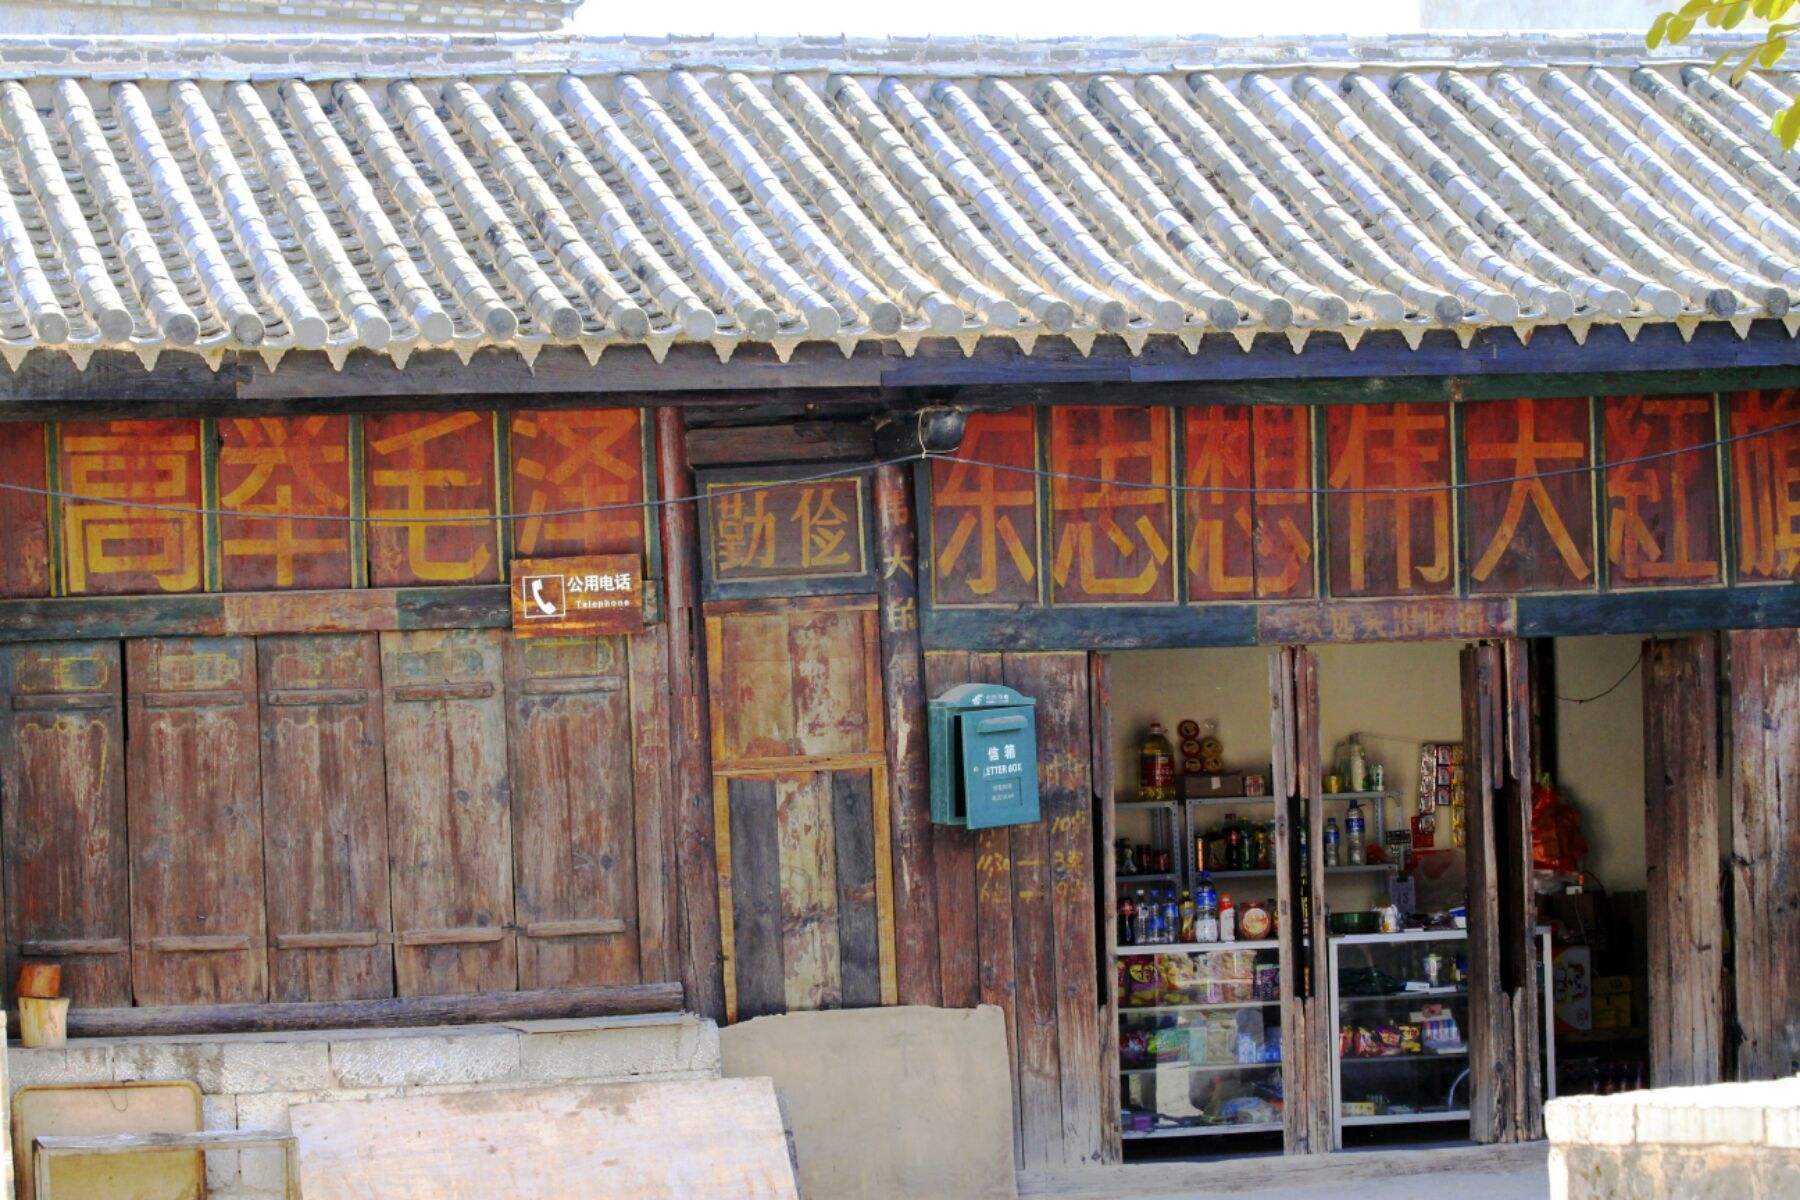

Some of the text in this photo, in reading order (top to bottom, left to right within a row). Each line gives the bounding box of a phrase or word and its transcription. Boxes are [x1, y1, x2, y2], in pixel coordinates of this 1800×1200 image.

[717, 488, 852, 572] 勤俭
[567, 573, 632, 593] 公用电话
[576, 599, 631, 609] Telephone
[988, 744, 1016, 762] 信箱
